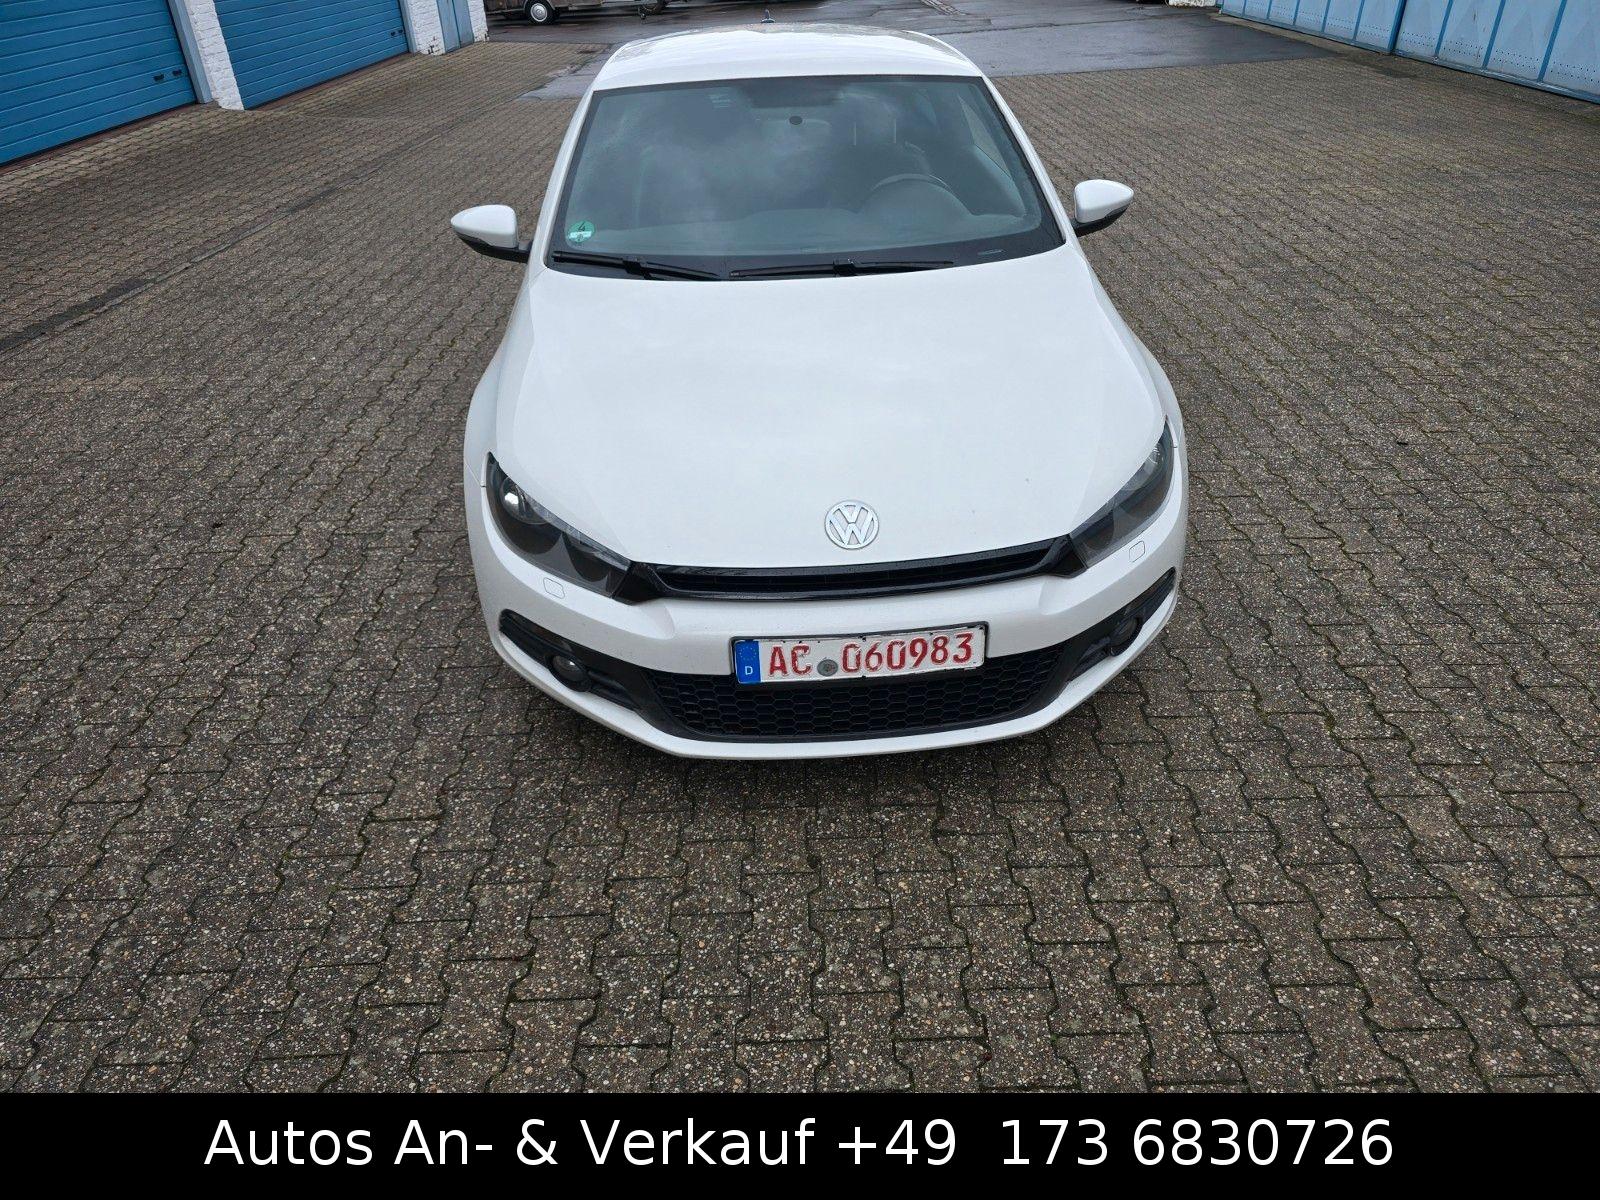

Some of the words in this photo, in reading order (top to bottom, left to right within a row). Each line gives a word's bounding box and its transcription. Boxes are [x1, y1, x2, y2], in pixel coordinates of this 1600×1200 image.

[825, 501, 879, 550] VW
[744, 666, 753, 676] D
[769, 644, 812, 677] AC
[842, 632, 974, 673] 060983
